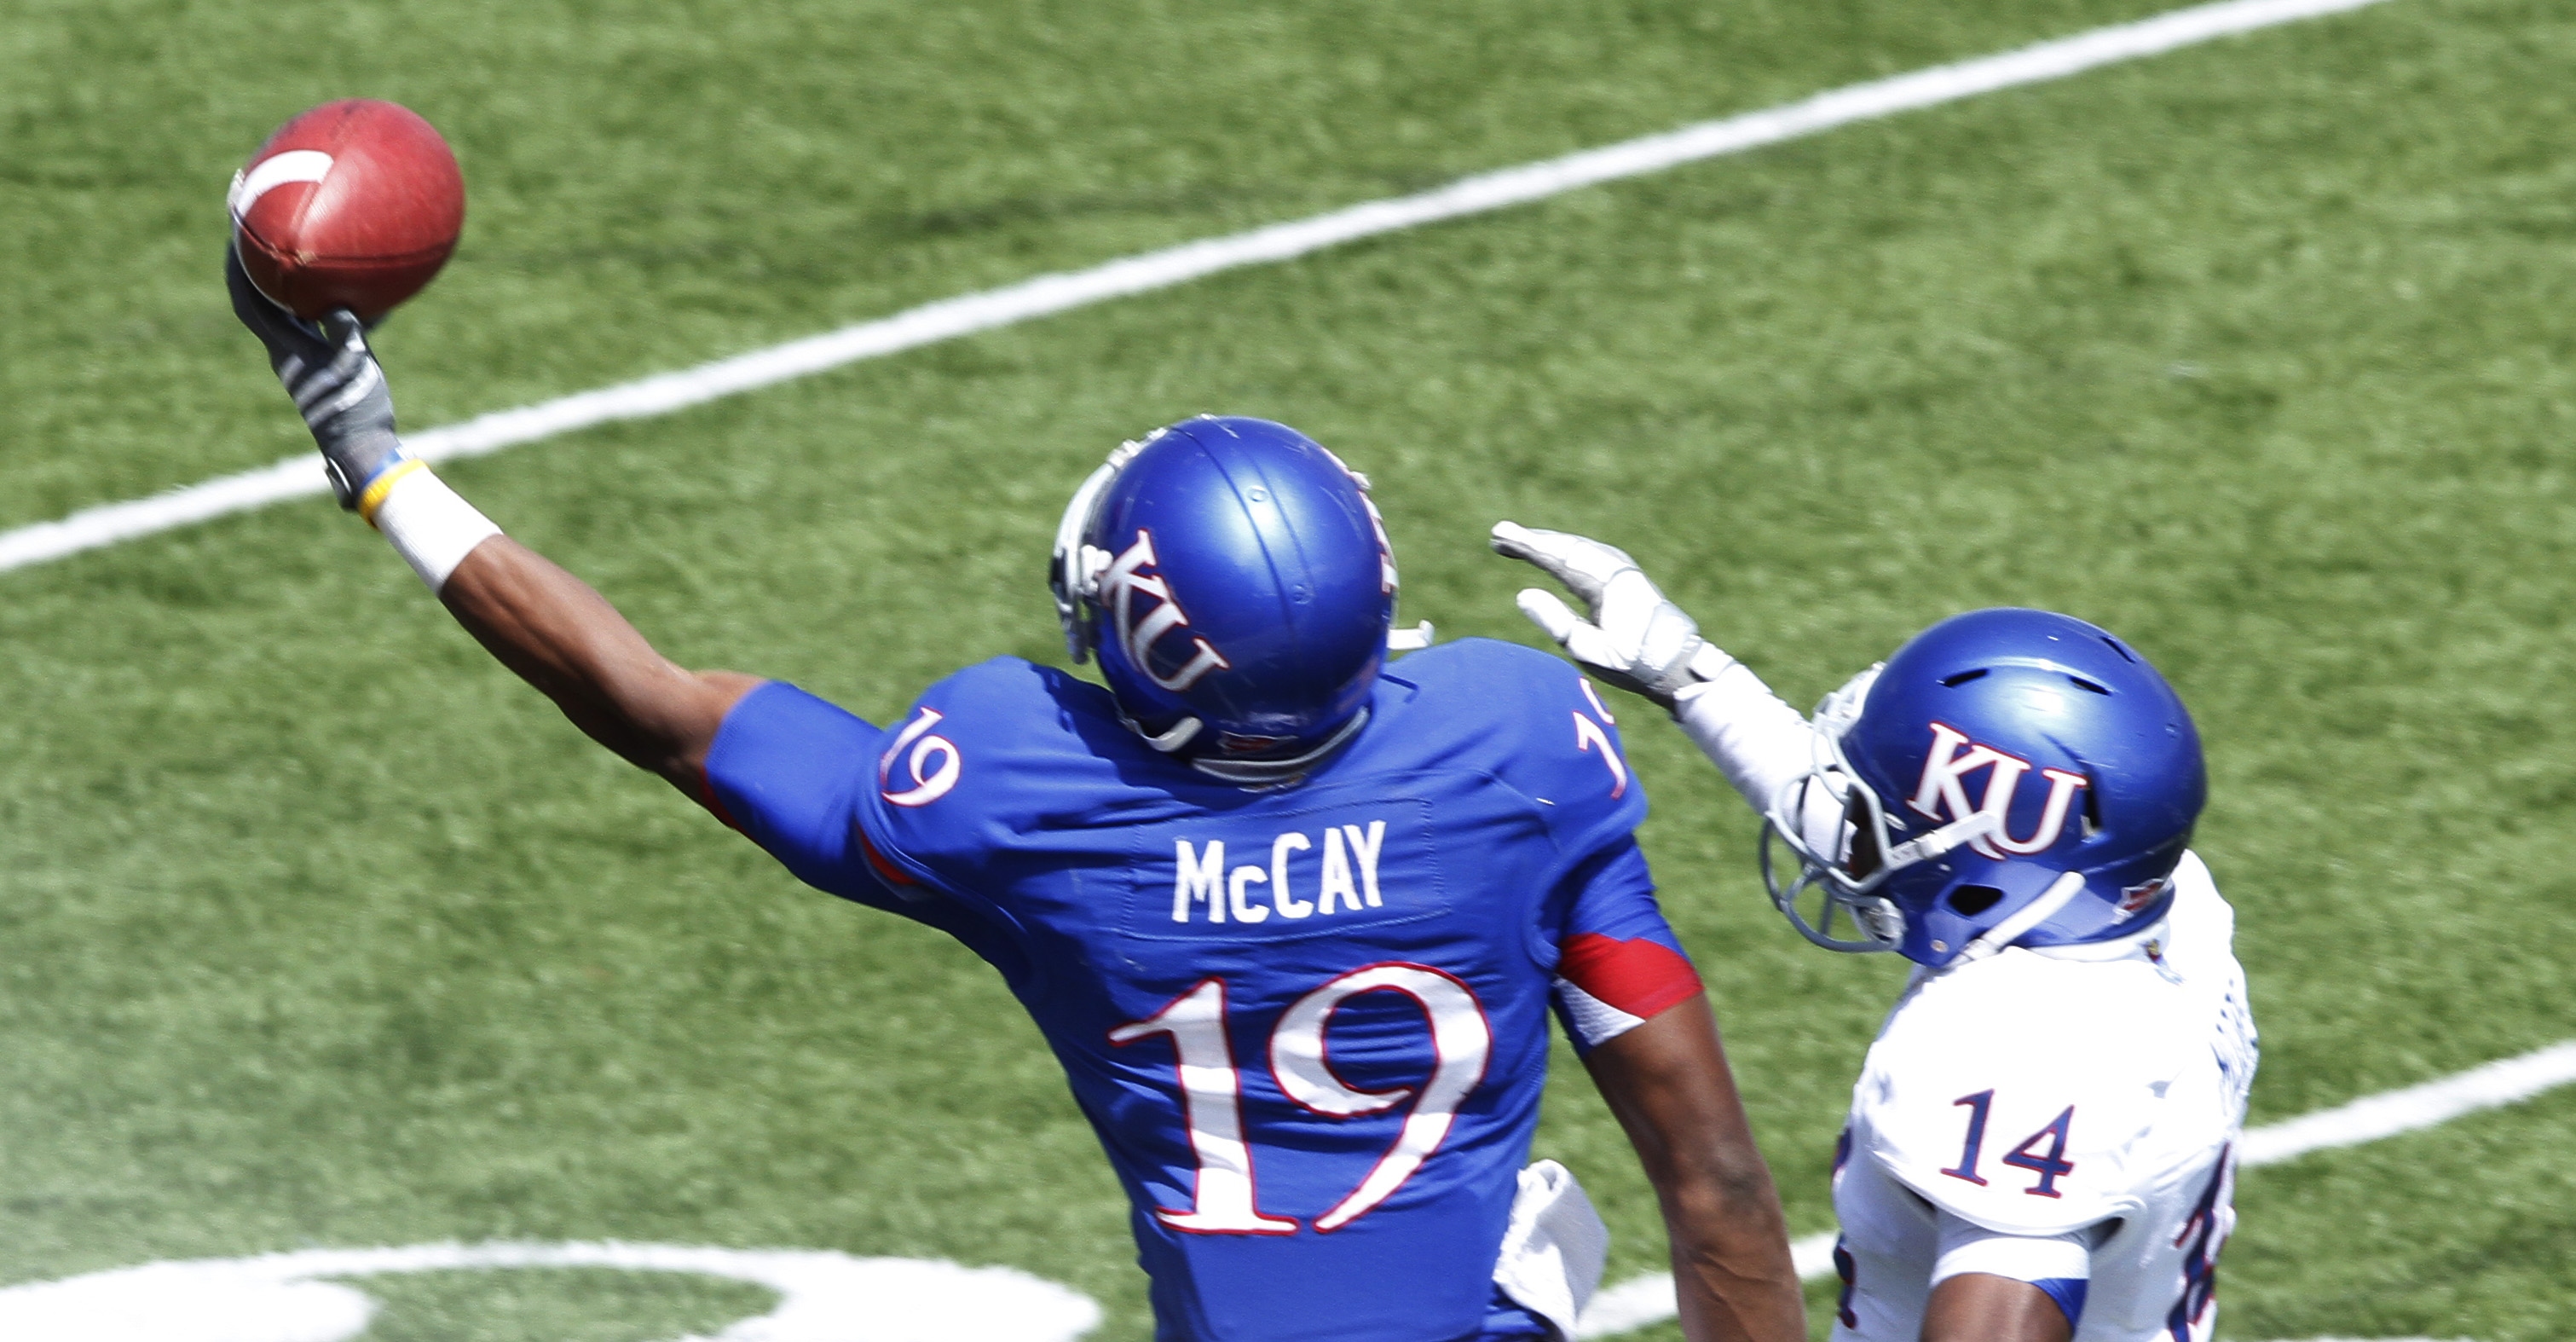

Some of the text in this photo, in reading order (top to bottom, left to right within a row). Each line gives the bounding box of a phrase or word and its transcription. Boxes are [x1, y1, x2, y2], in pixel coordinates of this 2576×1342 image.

[1098, 526, 1231, 692] KU
[879, 705, 963, 808] 19
[1905, 720, 2088, 861] KU
[1171, 819, 1387, 924] McCAY
[1107, 960, 1494, 1236] 19
[1940, 1089, 2076, 1200] 14
